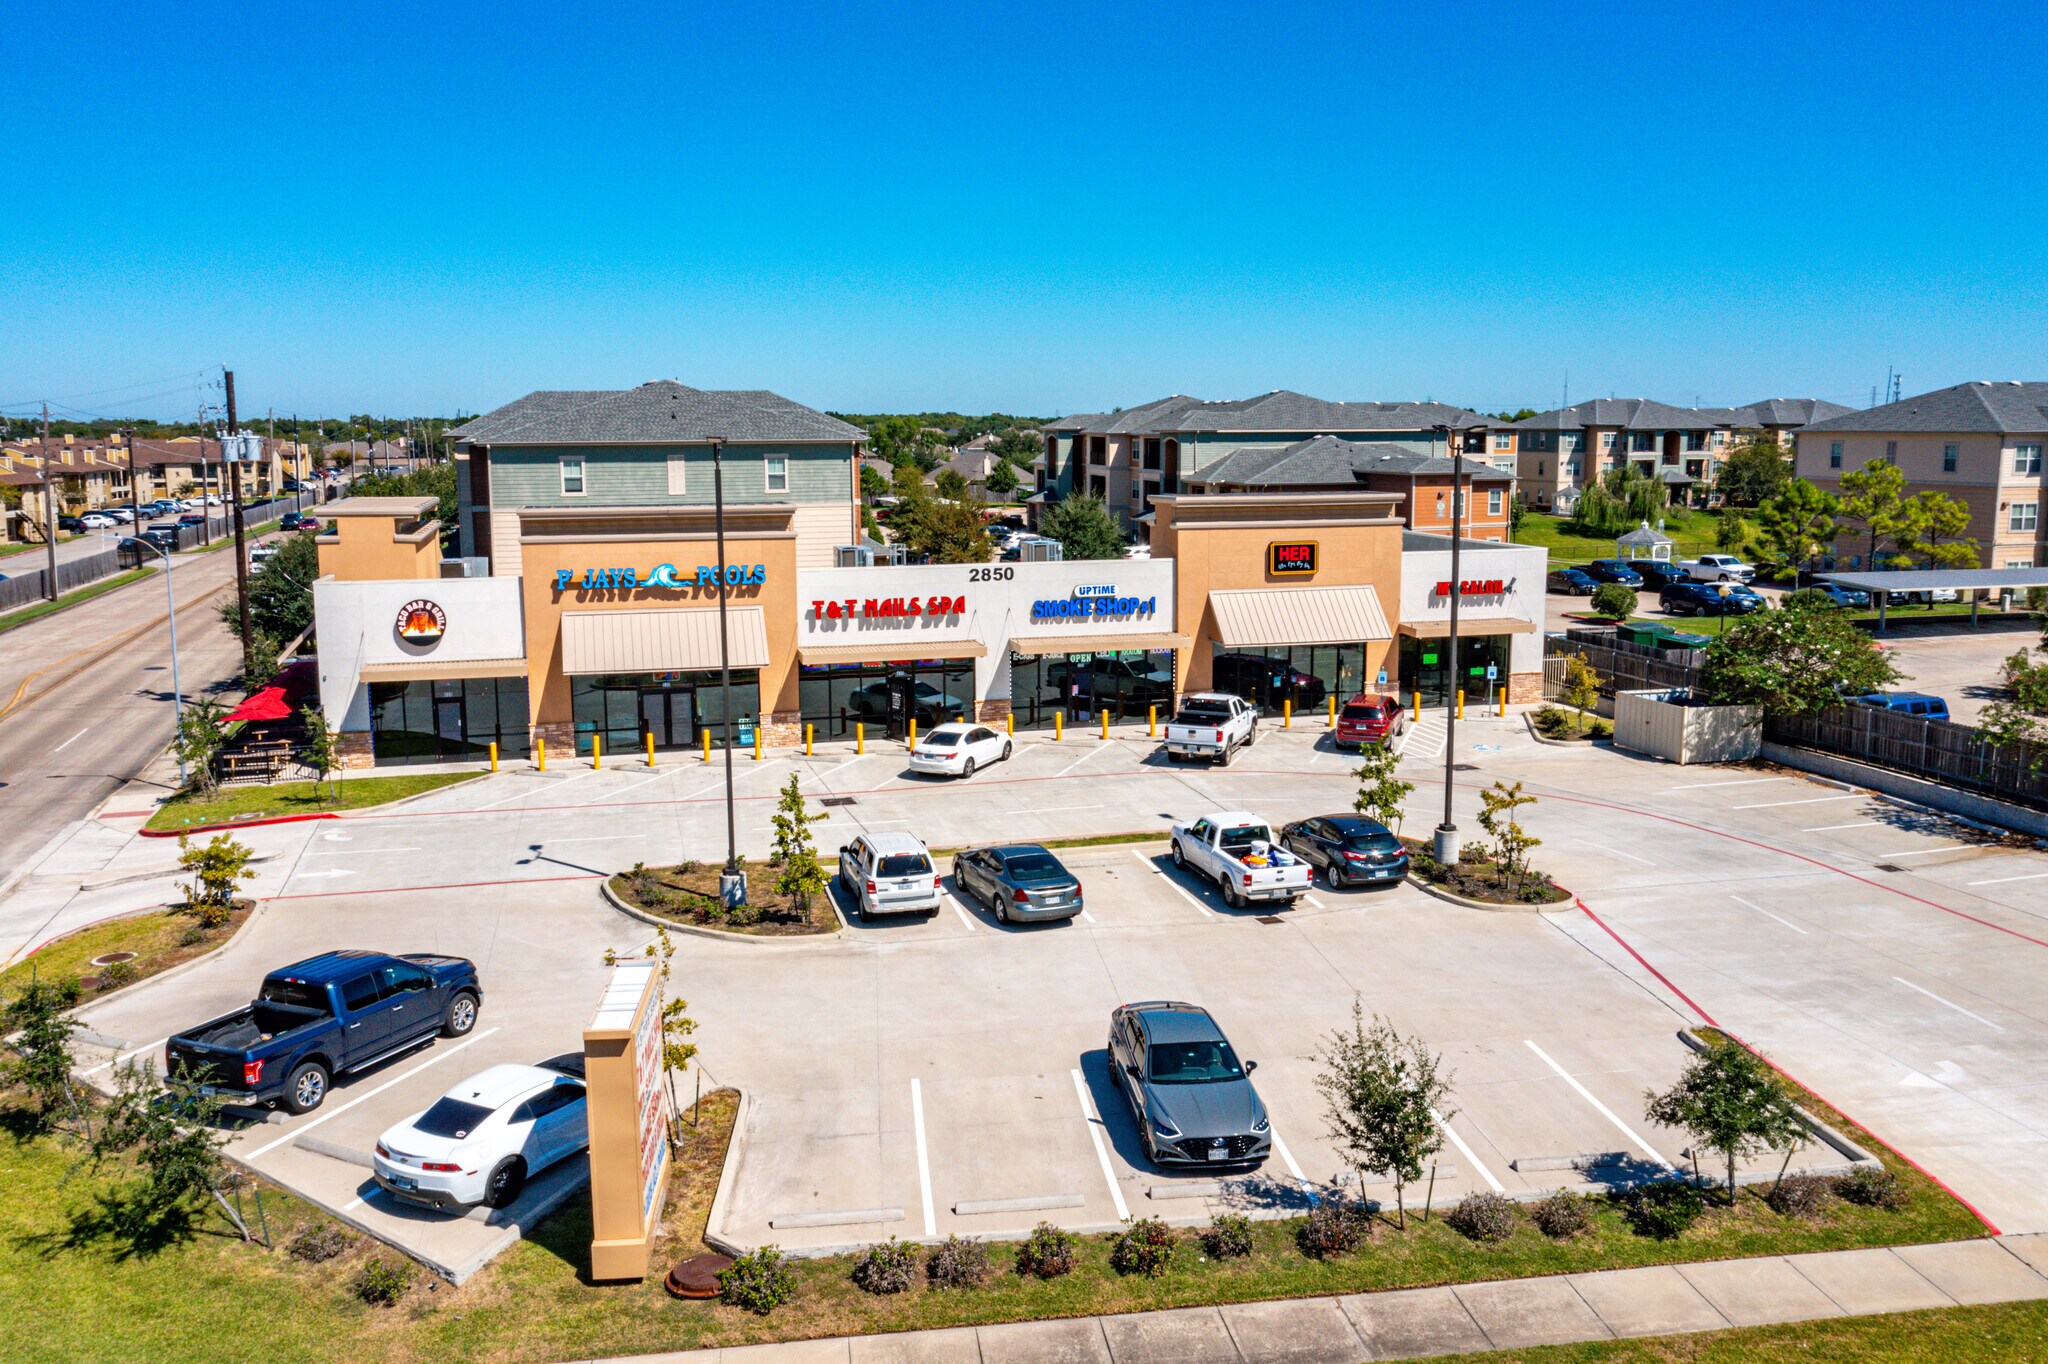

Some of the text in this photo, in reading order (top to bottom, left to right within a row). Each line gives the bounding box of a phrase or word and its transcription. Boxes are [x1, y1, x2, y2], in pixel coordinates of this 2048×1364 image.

[1279, 546, 1310, 561] HER
[581, 567, 636, 589] JAYS
[697, 564, 767, 586] POOLS
[969, 567, 1014, 582] 2850
[1460, 579, 1503, 595] SALON
[397, 600, 445, 633] TACO BAR & GRILL
[812, 595, 965, 620] T&T NAILS SPA
[1033, 596, 1156, 619] SMOKE SHOP #1
[1070, 654, 1092, 663] OPEN
